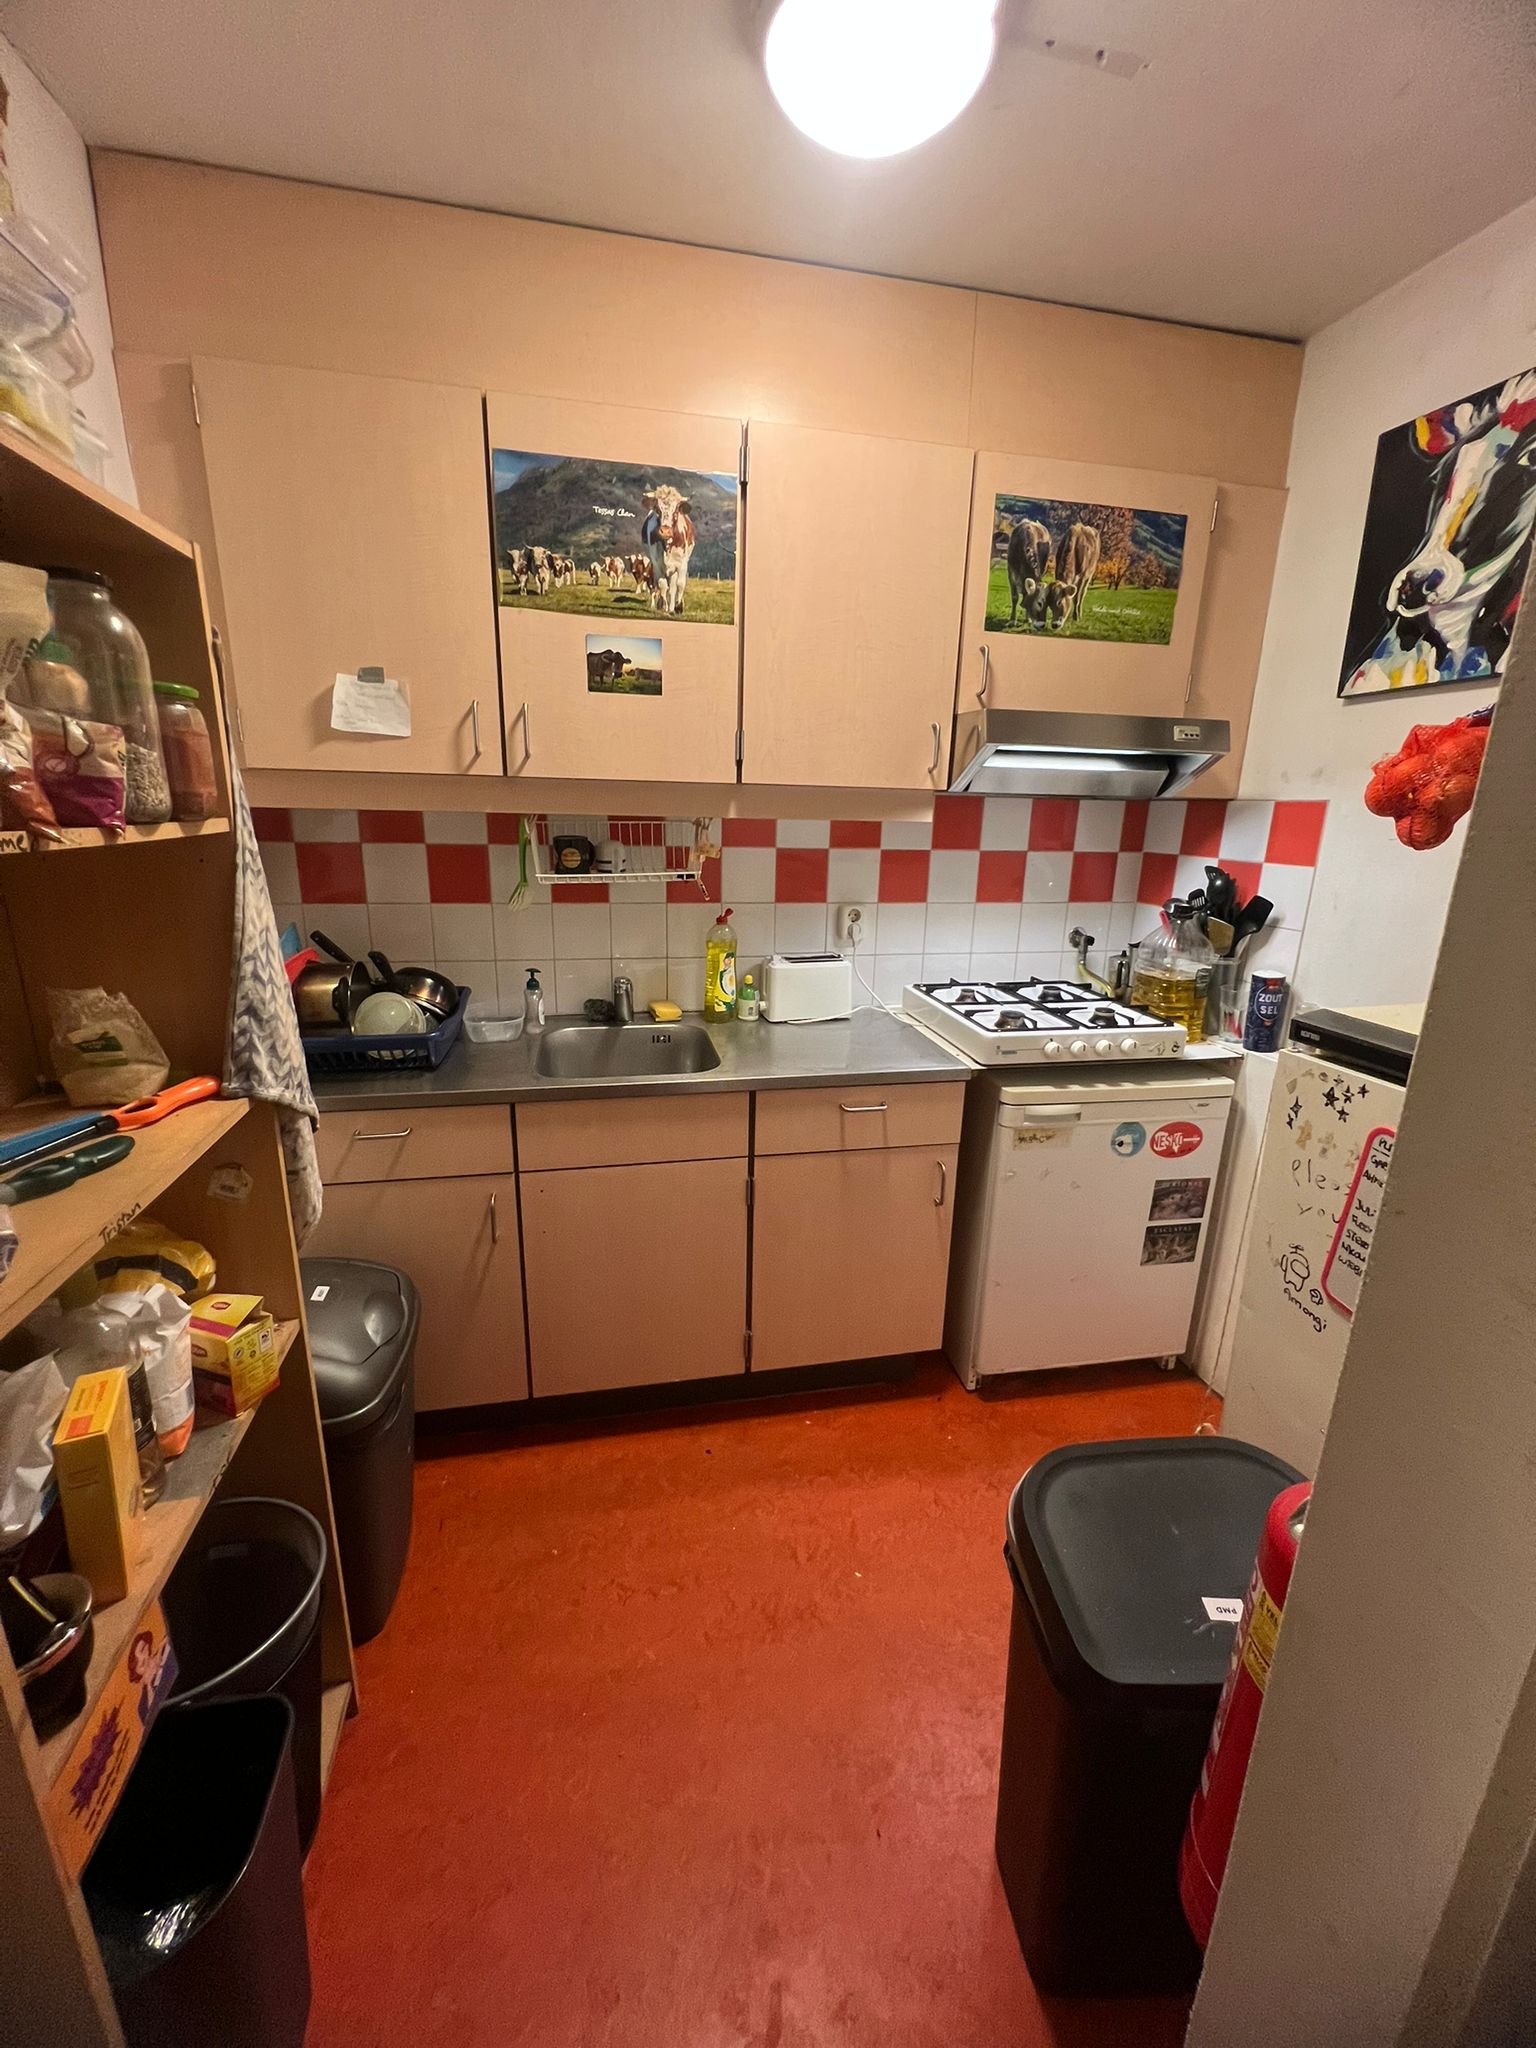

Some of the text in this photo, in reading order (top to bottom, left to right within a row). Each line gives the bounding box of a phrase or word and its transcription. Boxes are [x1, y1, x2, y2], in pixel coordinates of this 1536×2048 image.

[1258, 993, 1283, 1003] ZOUT
[1259, 1005, 1278, 1015] SEL
[1215, 1605, 1238, 1615] PMD
